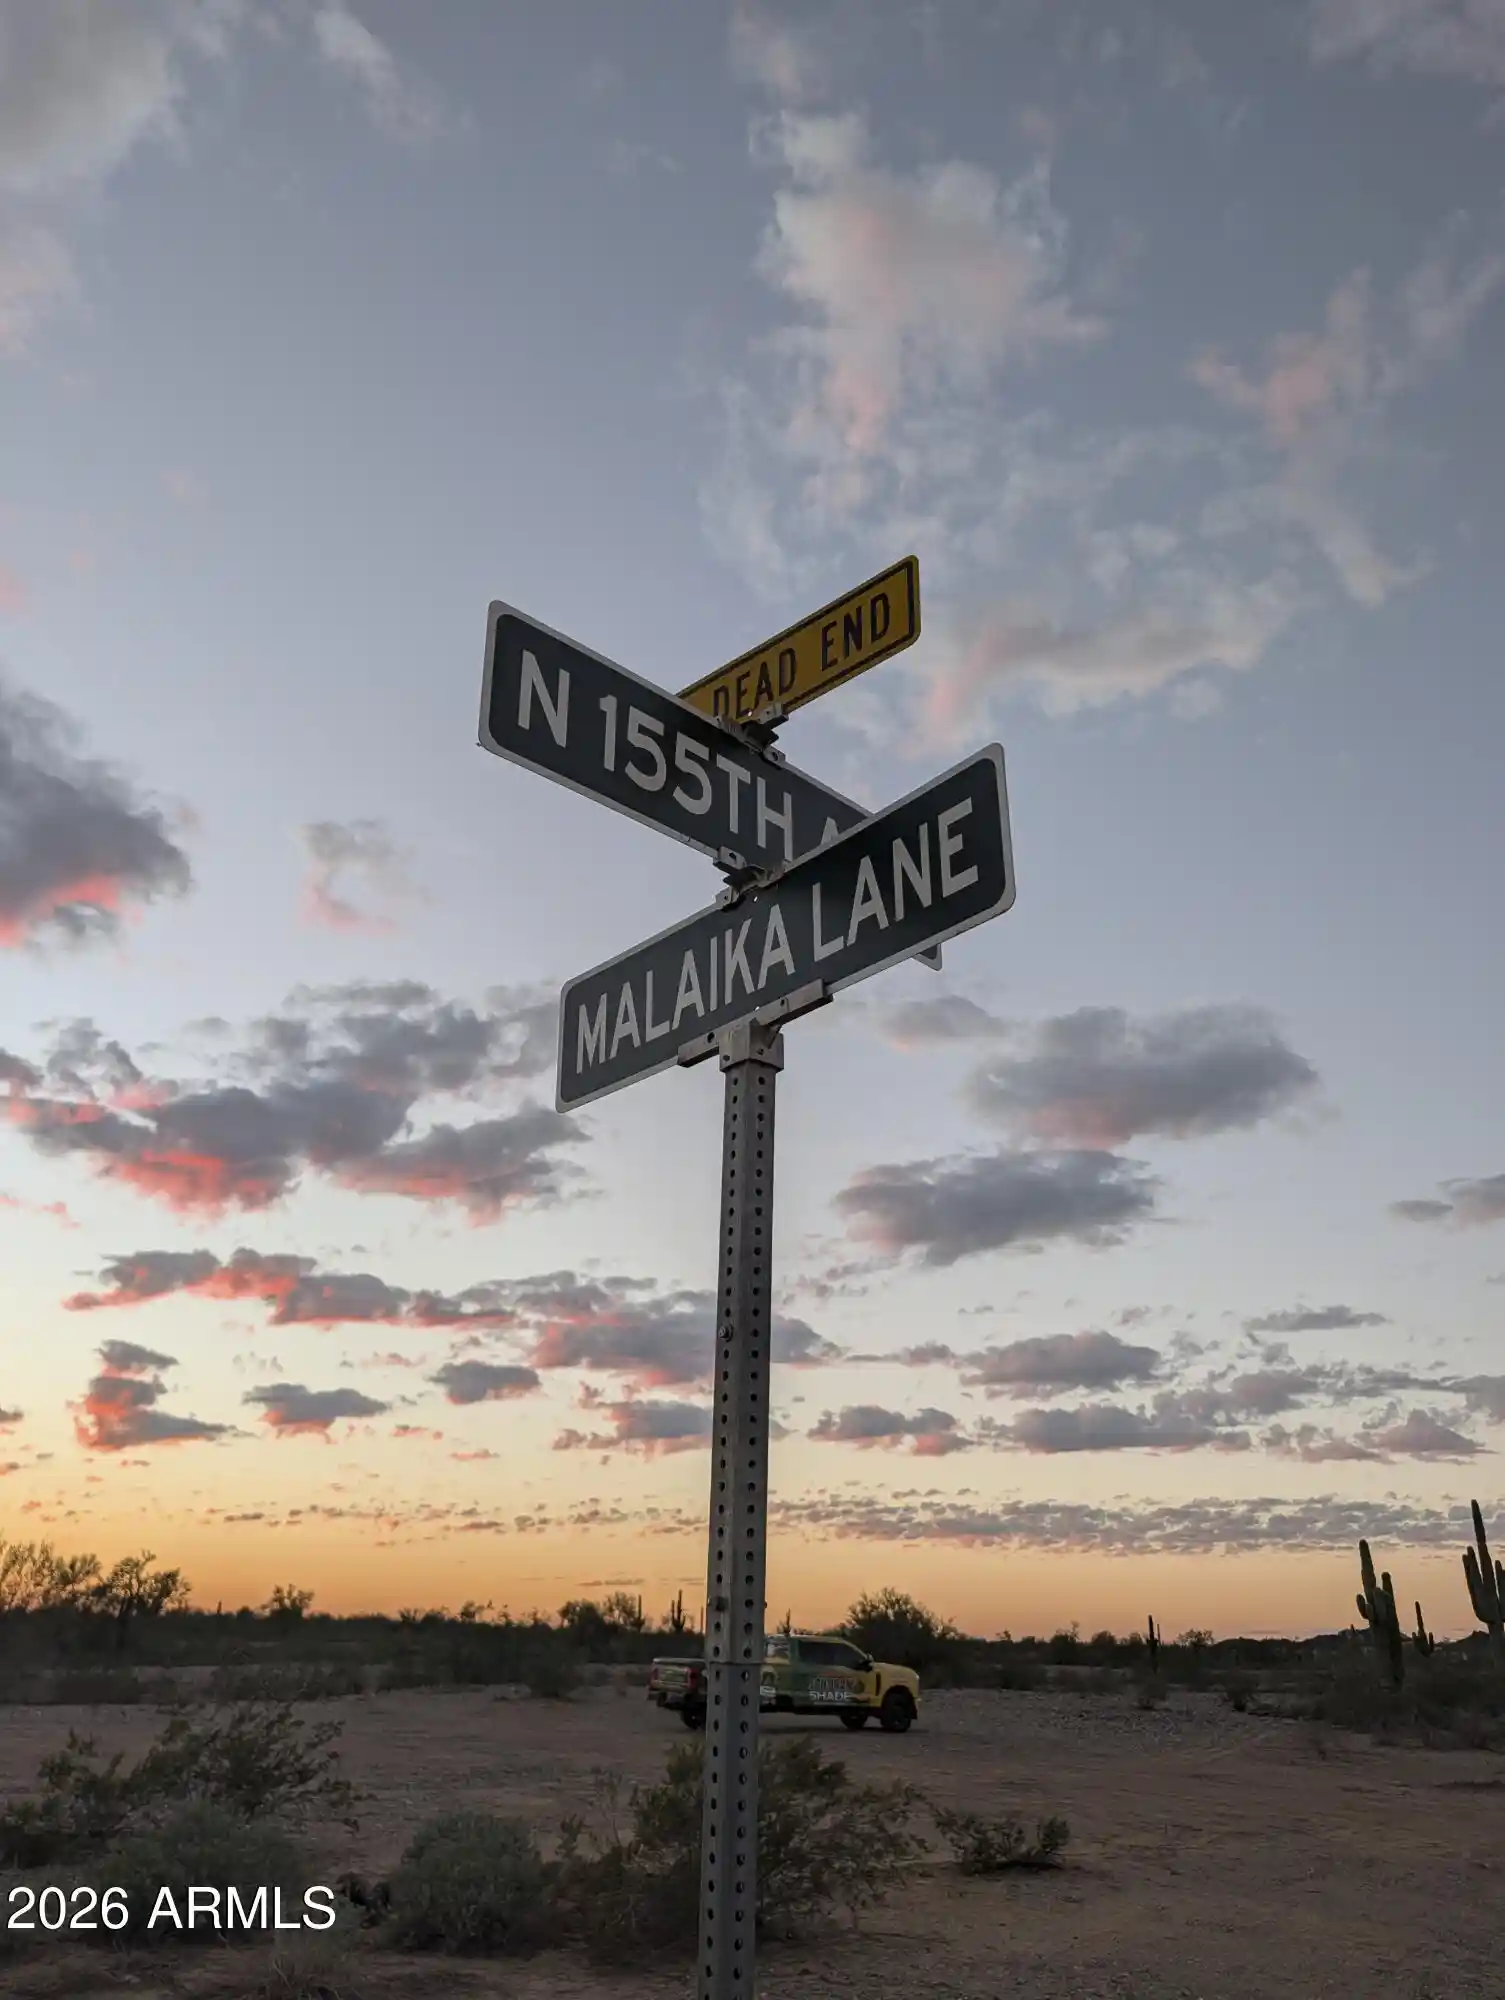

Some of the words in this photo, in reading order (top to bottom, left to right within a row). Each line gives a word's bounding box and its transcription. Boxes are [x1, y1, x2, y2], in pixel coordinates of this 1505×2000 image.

[516, 648, 571, 747] N
[599, 694, 793, 863] 155TH
[713, 648, 797, 719] DEAD
[821, 592, 890, 672] END
[575, 903, 796, 1074] MALAIKA
[811, 797, 979, 962] LANE
